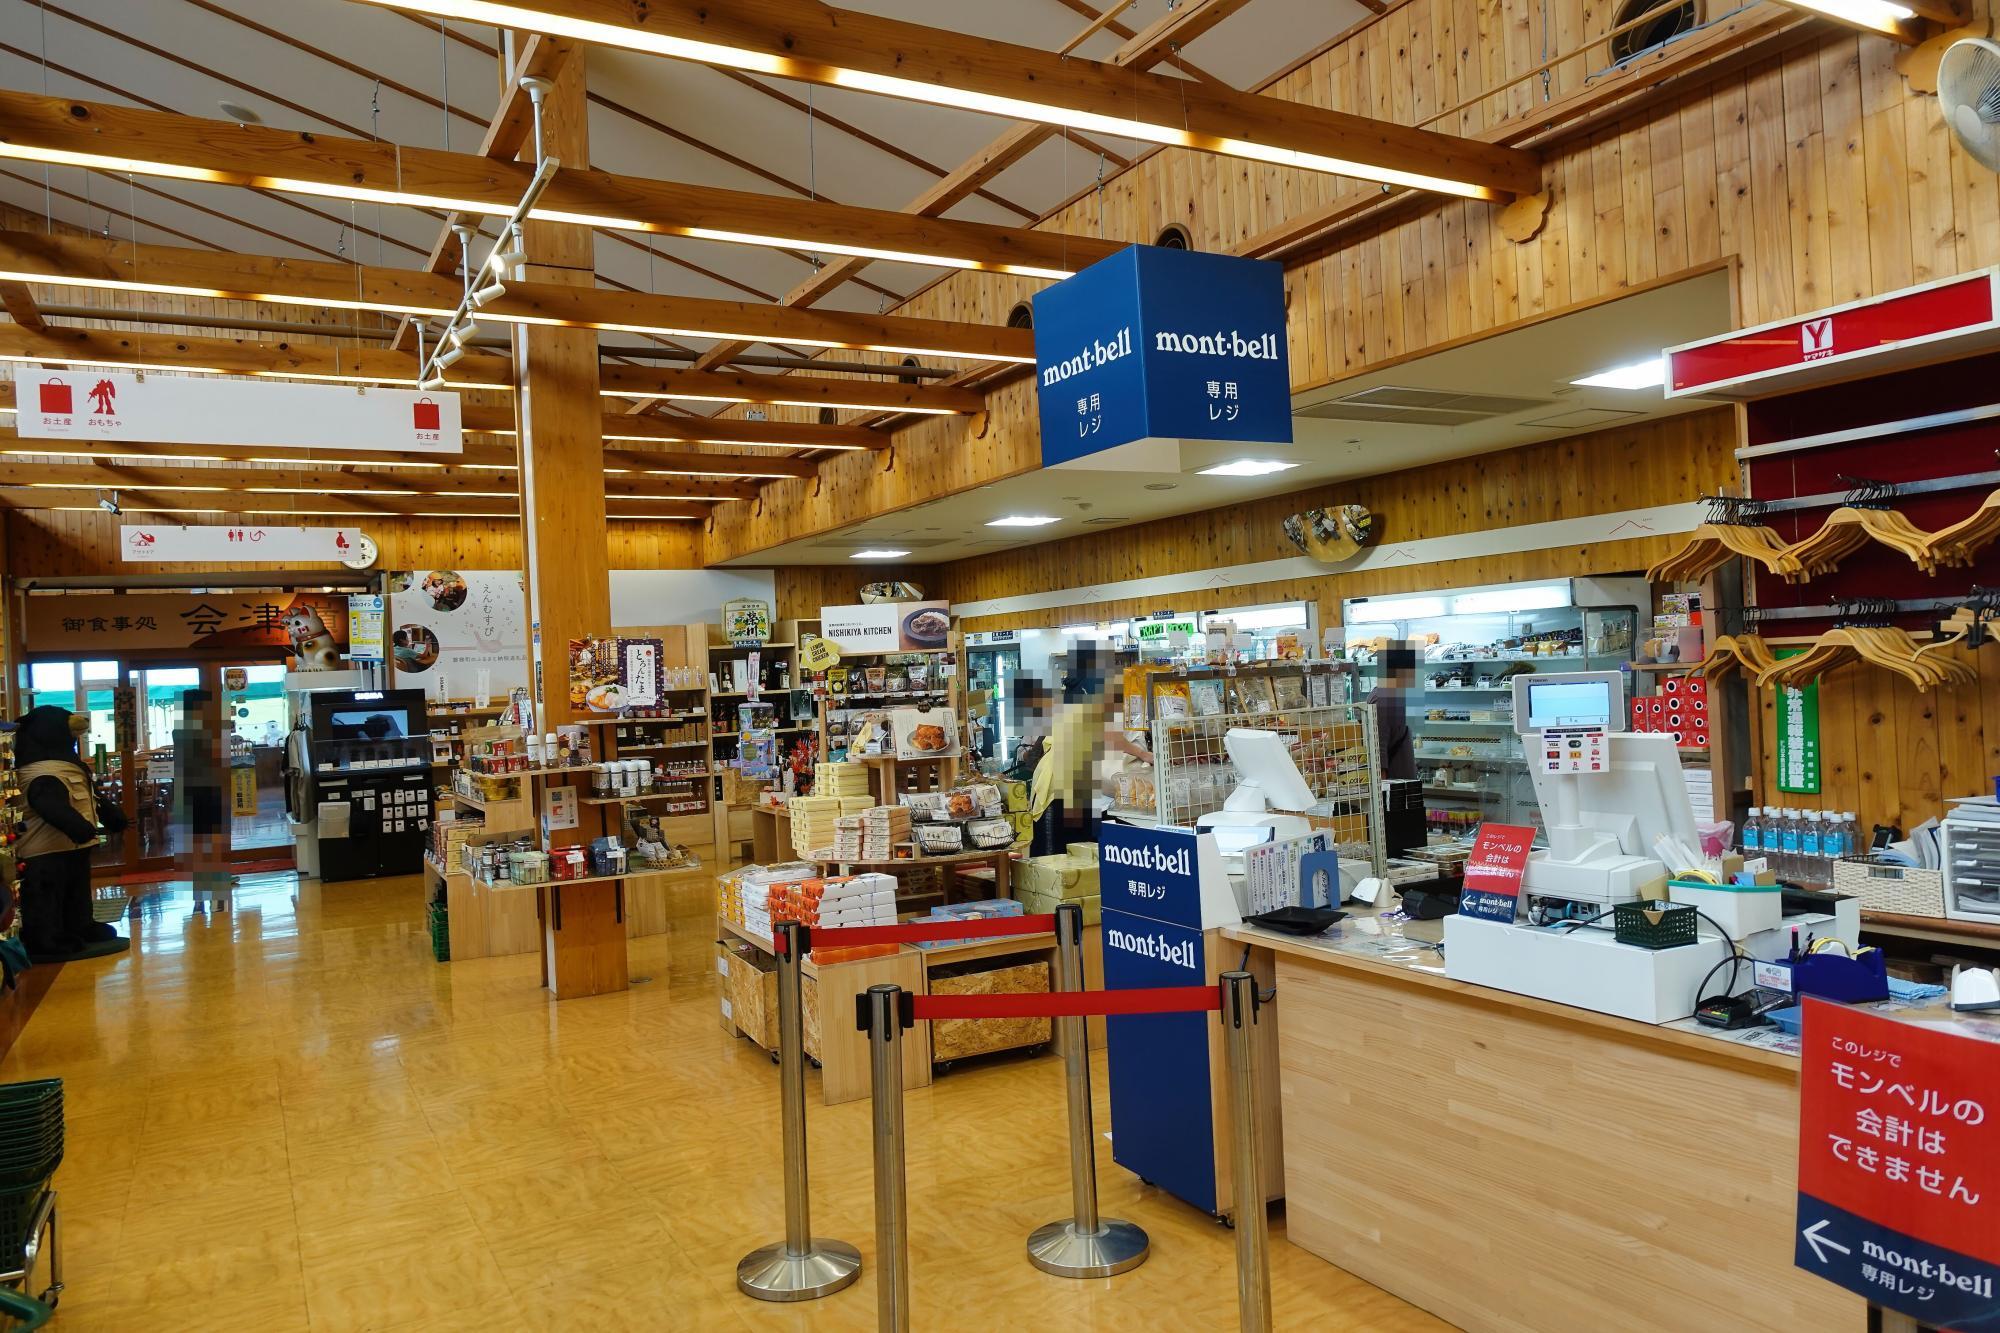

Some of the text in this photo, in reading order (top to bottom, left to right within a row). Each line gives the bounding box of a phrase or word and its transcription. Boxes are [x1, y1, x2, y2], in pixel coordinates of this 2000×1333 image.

[1805, 320, 1829, 348] Y
[1803, 350, 1833, 361] ヤマザキ
[1206, 380, 1238, 400] 専用
[1077, 393, 1101, 415] 専用
[1209, 404, 1239, 421] レジ
[43, 417, 72, 426] お土産
[88, 418, 122, 427] おもちゃ
[1079, 415, 1101, 437] レジ
[416, 433, 440, 441] お土産
[483, 584, 495, 637] えんむすび
[62, 615, 158, 633] 御食事処
[828, 626, 892, 638] NISHIKIYA KITCHEN
[810, 642, 824, 652] LEMON
[812, 648, 826, 657] CREAM
[812, 652, 830, 663] CHICKEN
[1482, 841, 1522, 853] モンベルの
[1485, 853, 1510, 864] 会計は
[1128, 879, 1166, 900] 専用レジ
[1831, 1036, 1901, 1068] このレジで
[1830, 1061, 1985, 1126] モンベルの
[1856, 1107, 1946, 1155] 会計は
[1828, 1133, 1980, 1206] できません
[1861, 1262, 1935, 1301] 専用レジ
